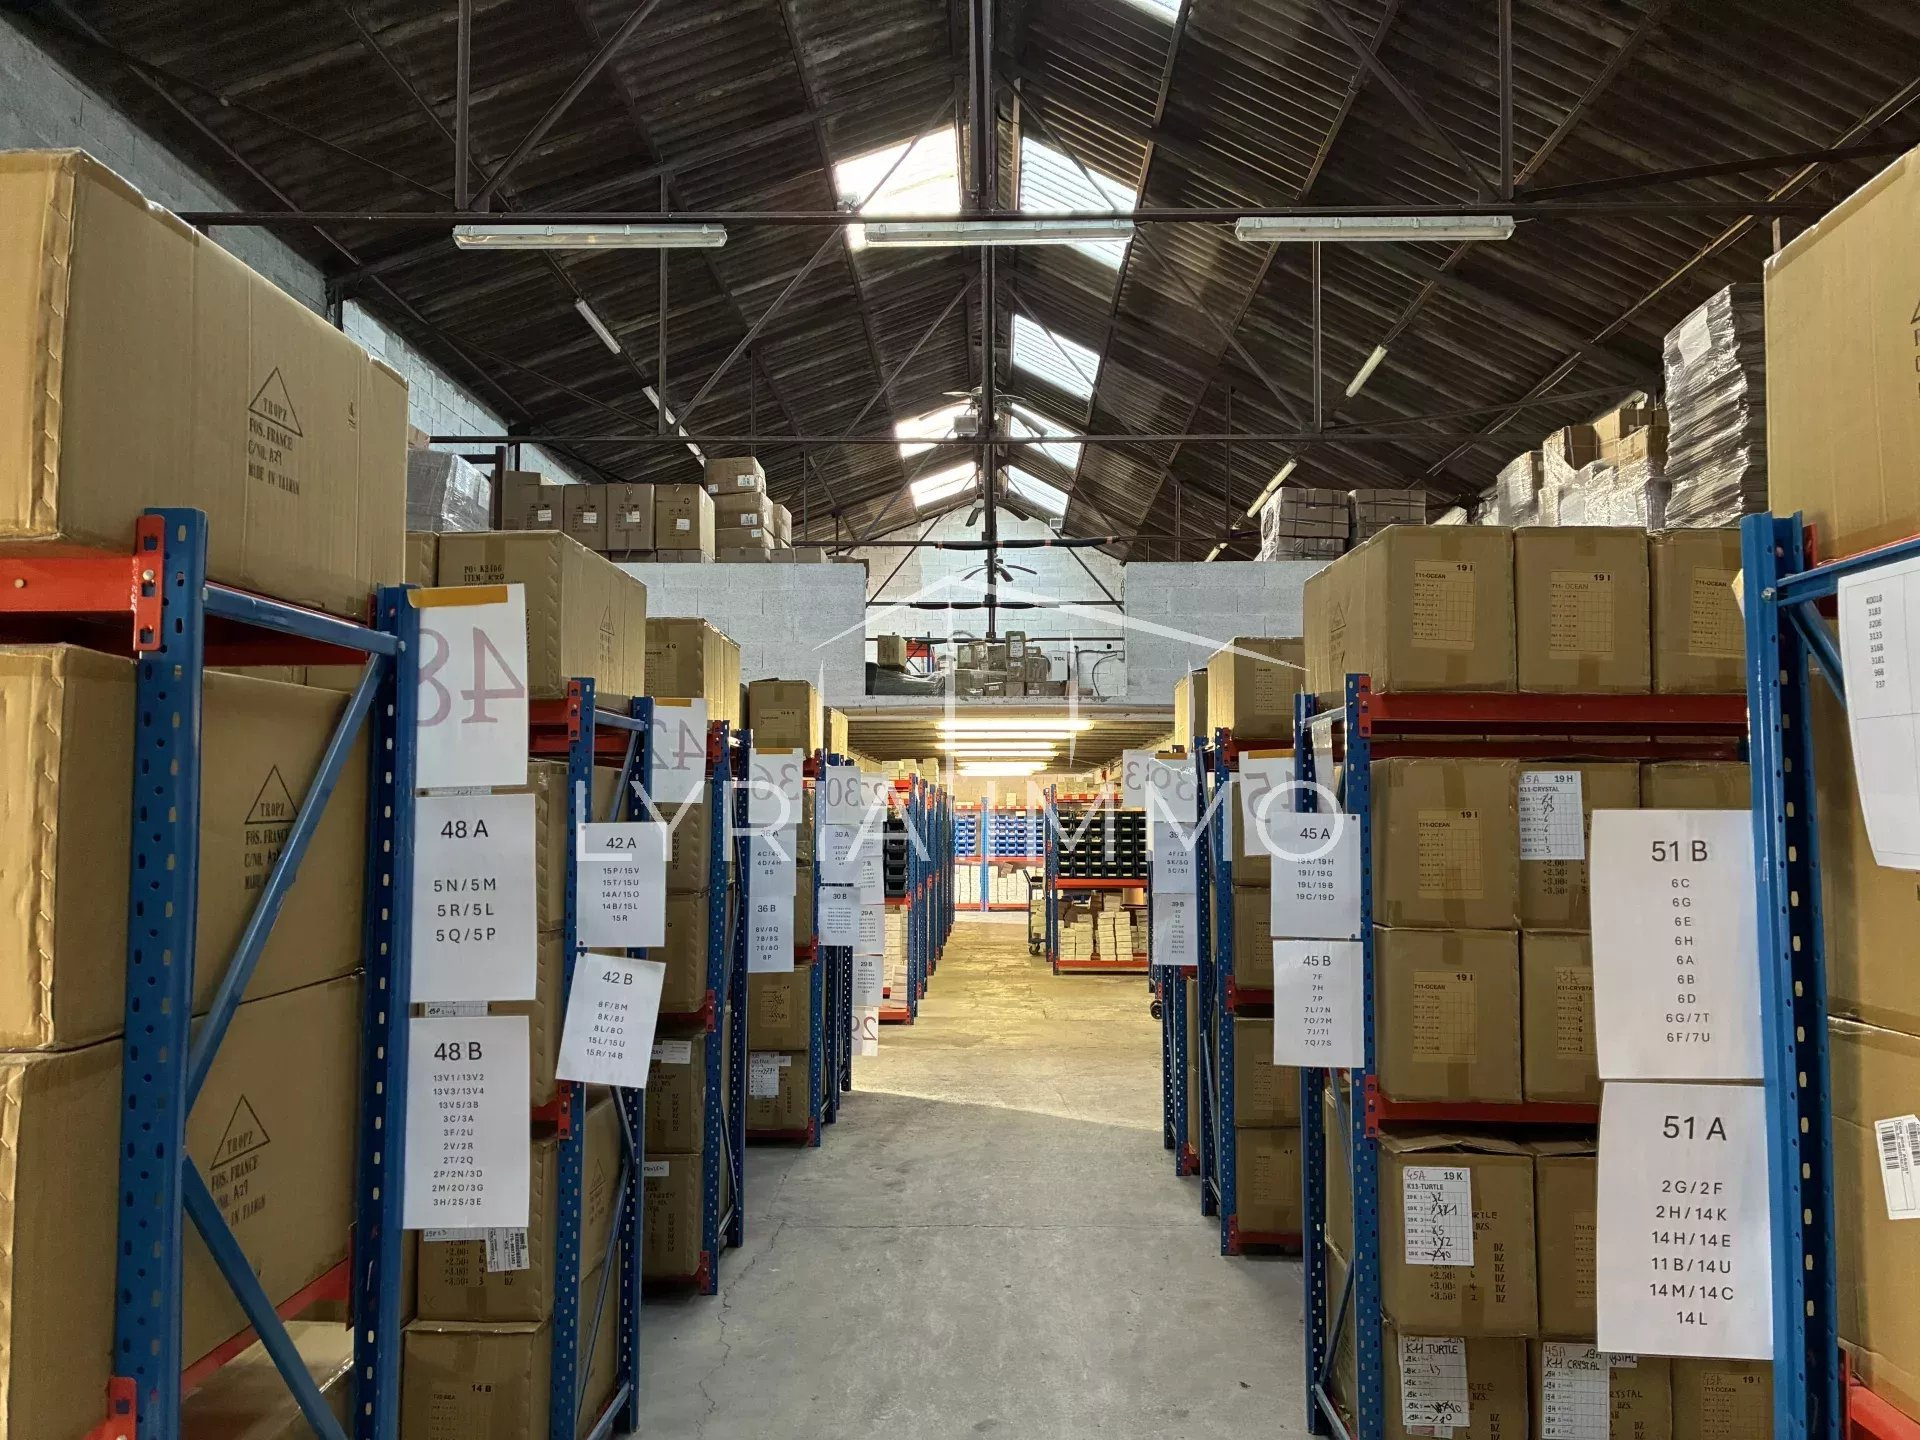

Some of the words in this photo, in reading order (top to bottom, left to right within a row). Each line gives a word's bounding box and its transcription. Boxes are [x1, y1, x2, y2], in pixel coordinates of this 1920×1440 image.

[267, 427, 293, 450] FRANCE
[1554, 775, 1565, 783] 19
[441, 820, 467, 839] 48
[474, 819, 488, 838] A
[1300, 828, 1317, 839] 45
[1321, 828, 1331, 839] A
[606, 837, 624, 849] 42
[627, 837, 637, 849] A
[1651, 841, 1679, 862] 51
[1692, 840, 1708, 862] B
[758, 905, 769, 913] 36
[771, 905, 776, 913] B
[1303, 955, 1319, 966] 45
[1323, 955, 1332, 966] B
[602, 971, 620, 984] 42
[624, 973, 633, 985] B
[1456, 973, 1468, 982] 19
[434, 1042, 461, 1061] 48
[468, 1042, 482, 1061] B
[1663, 1116, 1694, 1140] 51
[1706, 1117, 1727, 1141] A
[1443, 1172, 1455, 1180] 19
[1456, 1172, 1463, 1180] K
[1426, 1343, 1458, 1355] TURTLE
[1567, 1360, 1600, 1371] CRYSTAL
[1743, 1376, 1754, 1384] 19
[471, 1384, 483, 1392] 14
[485, 1384, 492, 1392] B
